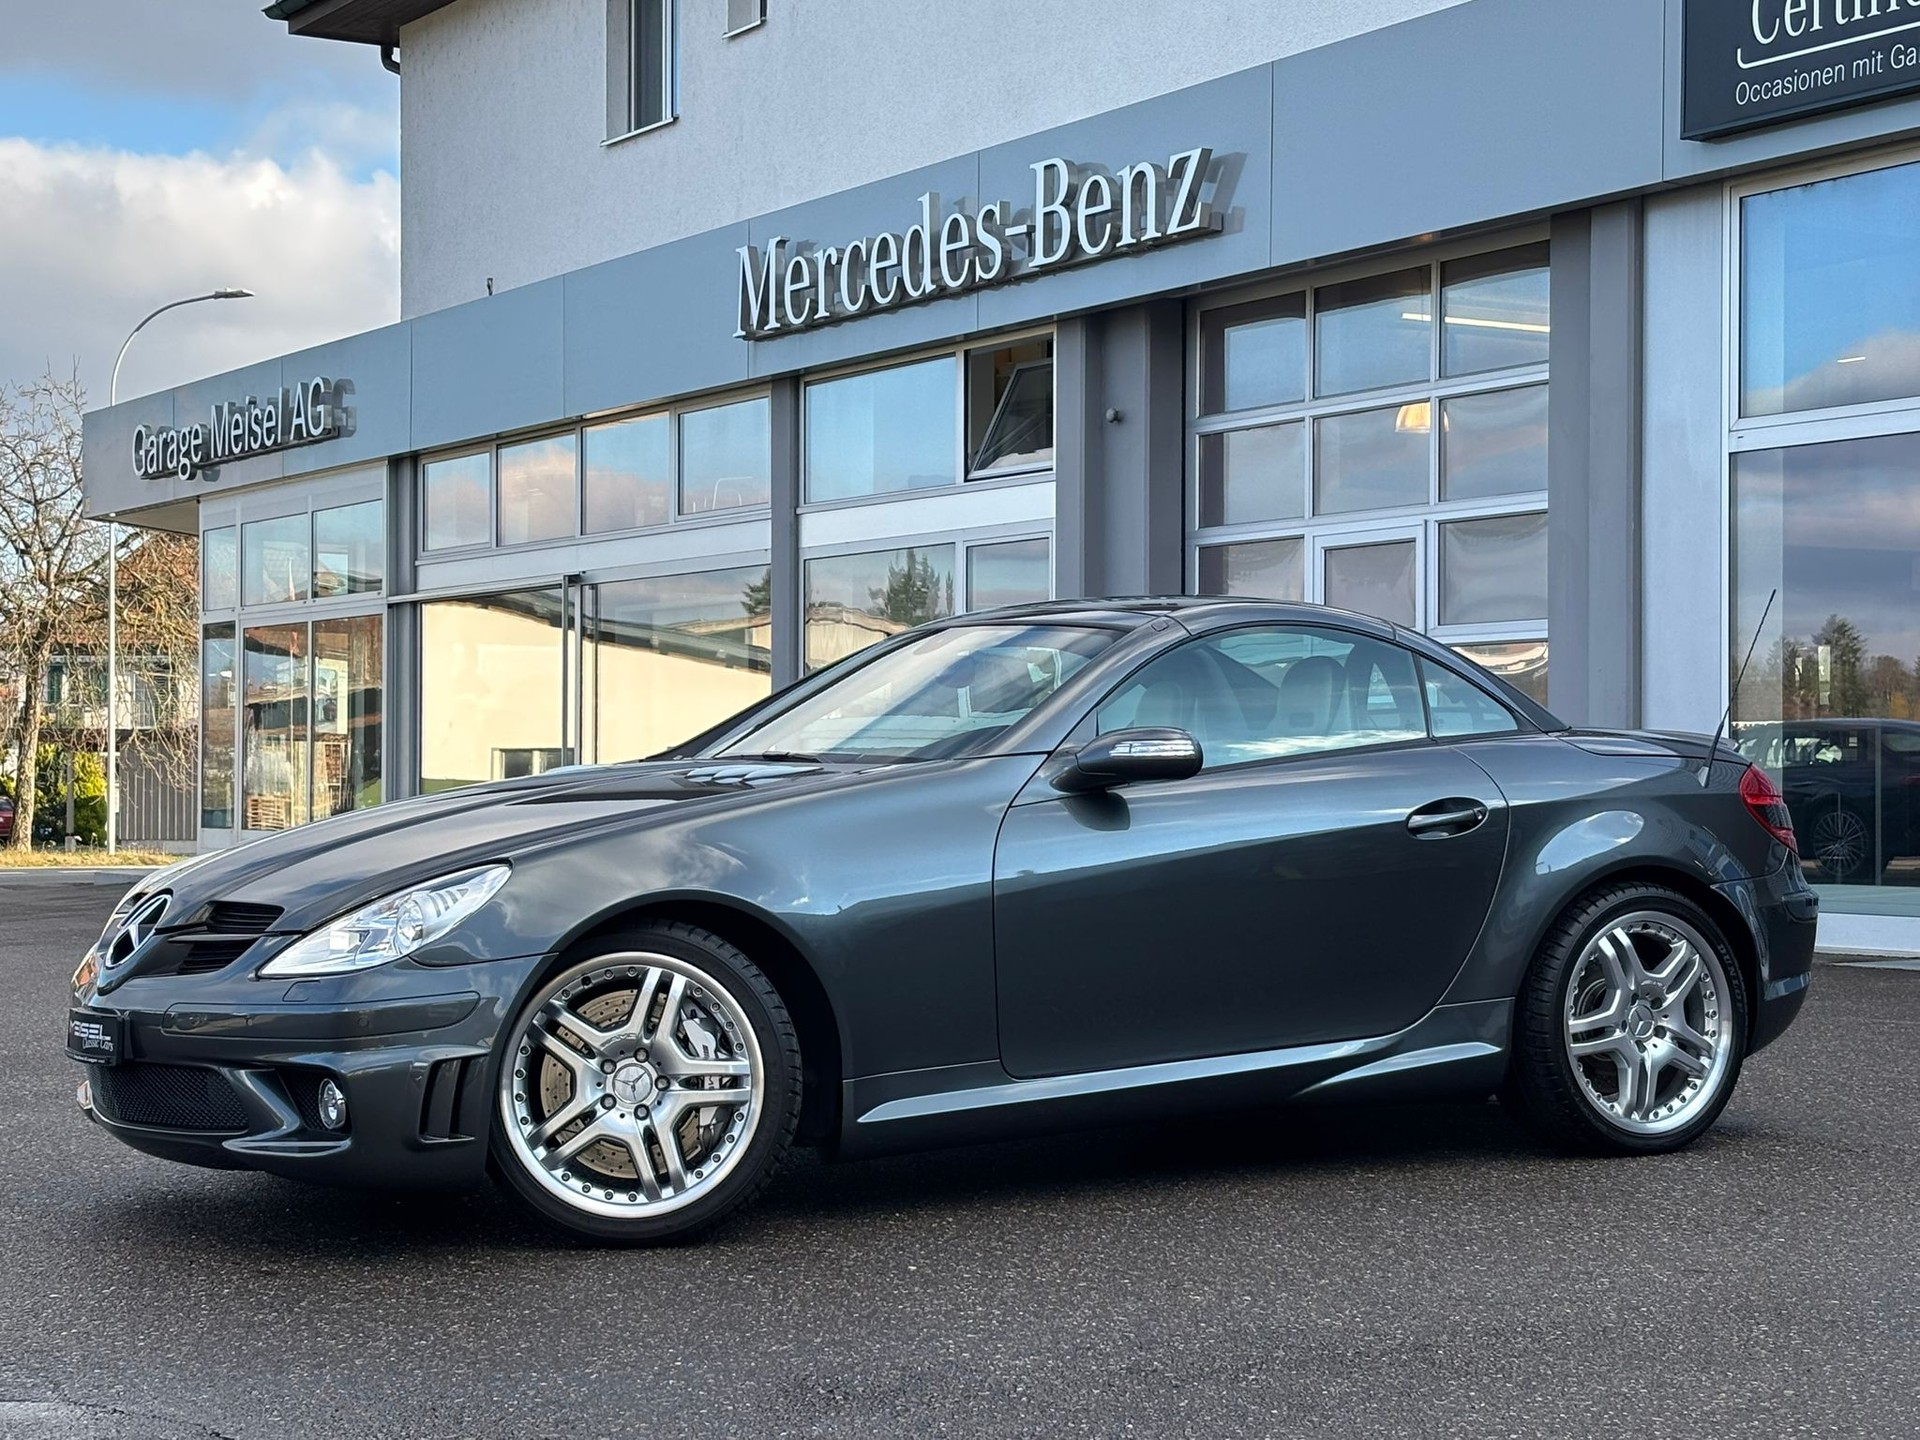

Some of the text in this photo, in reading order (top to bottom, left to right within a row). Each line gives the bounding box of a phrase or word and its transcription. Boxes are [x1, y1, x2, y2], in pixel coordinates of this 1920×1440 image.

[1736, 44, 1920, 105] Occasionen mit Ga
[733, 147, 1214, 339] Mercedes-Benz
[132, 376, 326, 481] Garage Meisel AG
